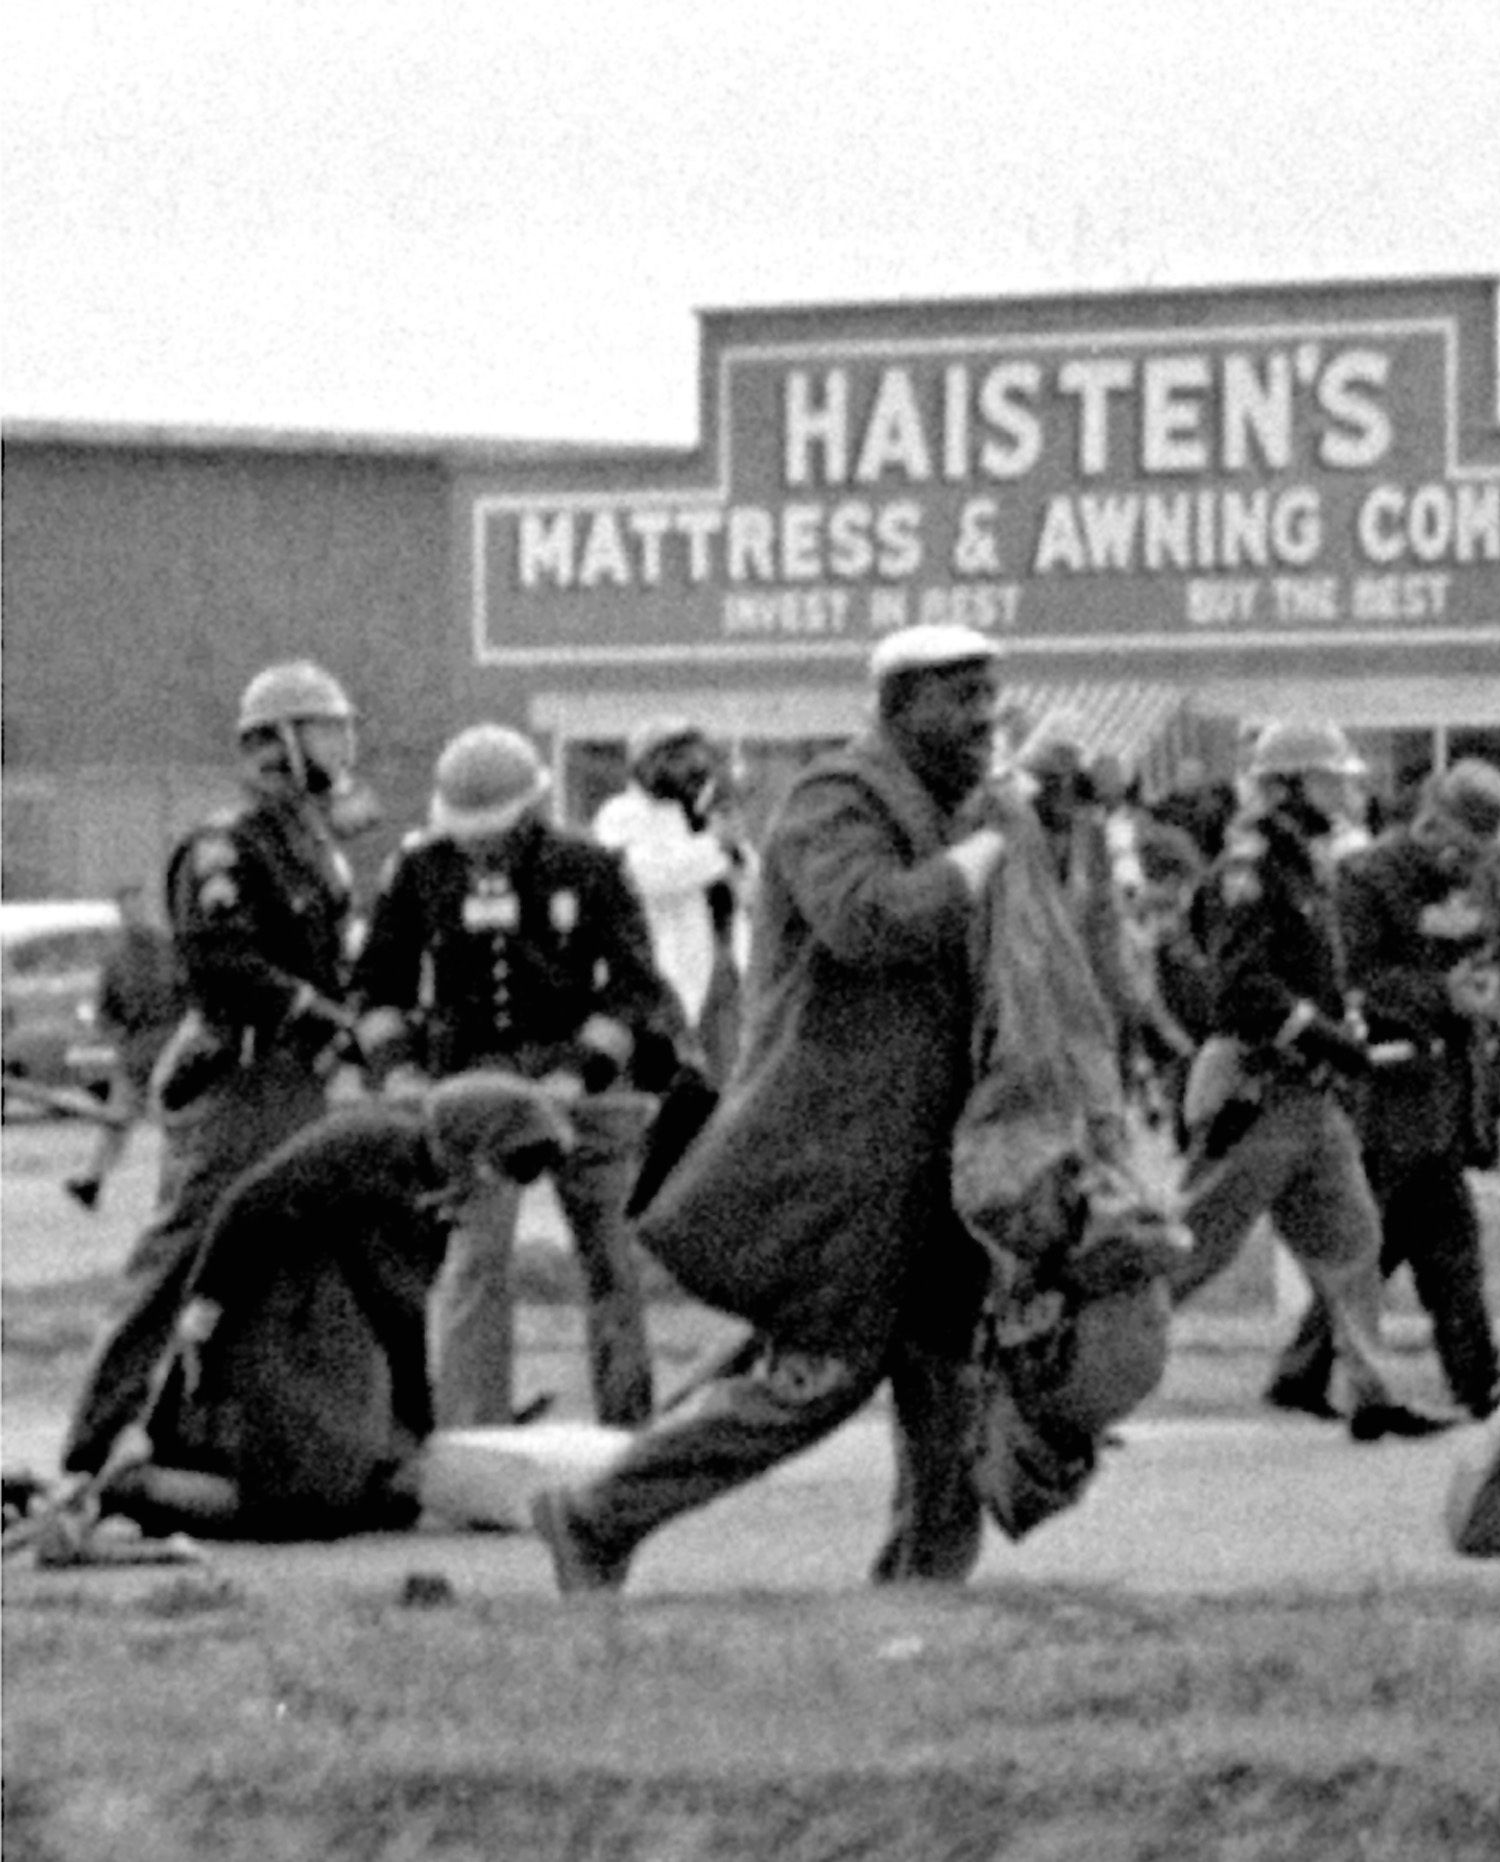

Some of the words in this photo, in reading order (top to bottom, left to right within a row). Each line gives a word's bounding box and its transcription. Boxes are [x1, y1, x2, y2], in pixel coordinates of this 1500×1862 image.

[783, 343, 1394, 485] HAISTEN'S
[518, 500, 923, 587] MATTRESS
[953, 498, 1000, 575] &
[1033, 483, 1323, 572] AWNING
[722, 587, 849, 634] INVEST
[871, 585, 906, 630] IN
[1185, 574, 1259, 624] BUY
[1270, 573, 1339, 621] THE
[1351, 571, 1452, 620] BEST
